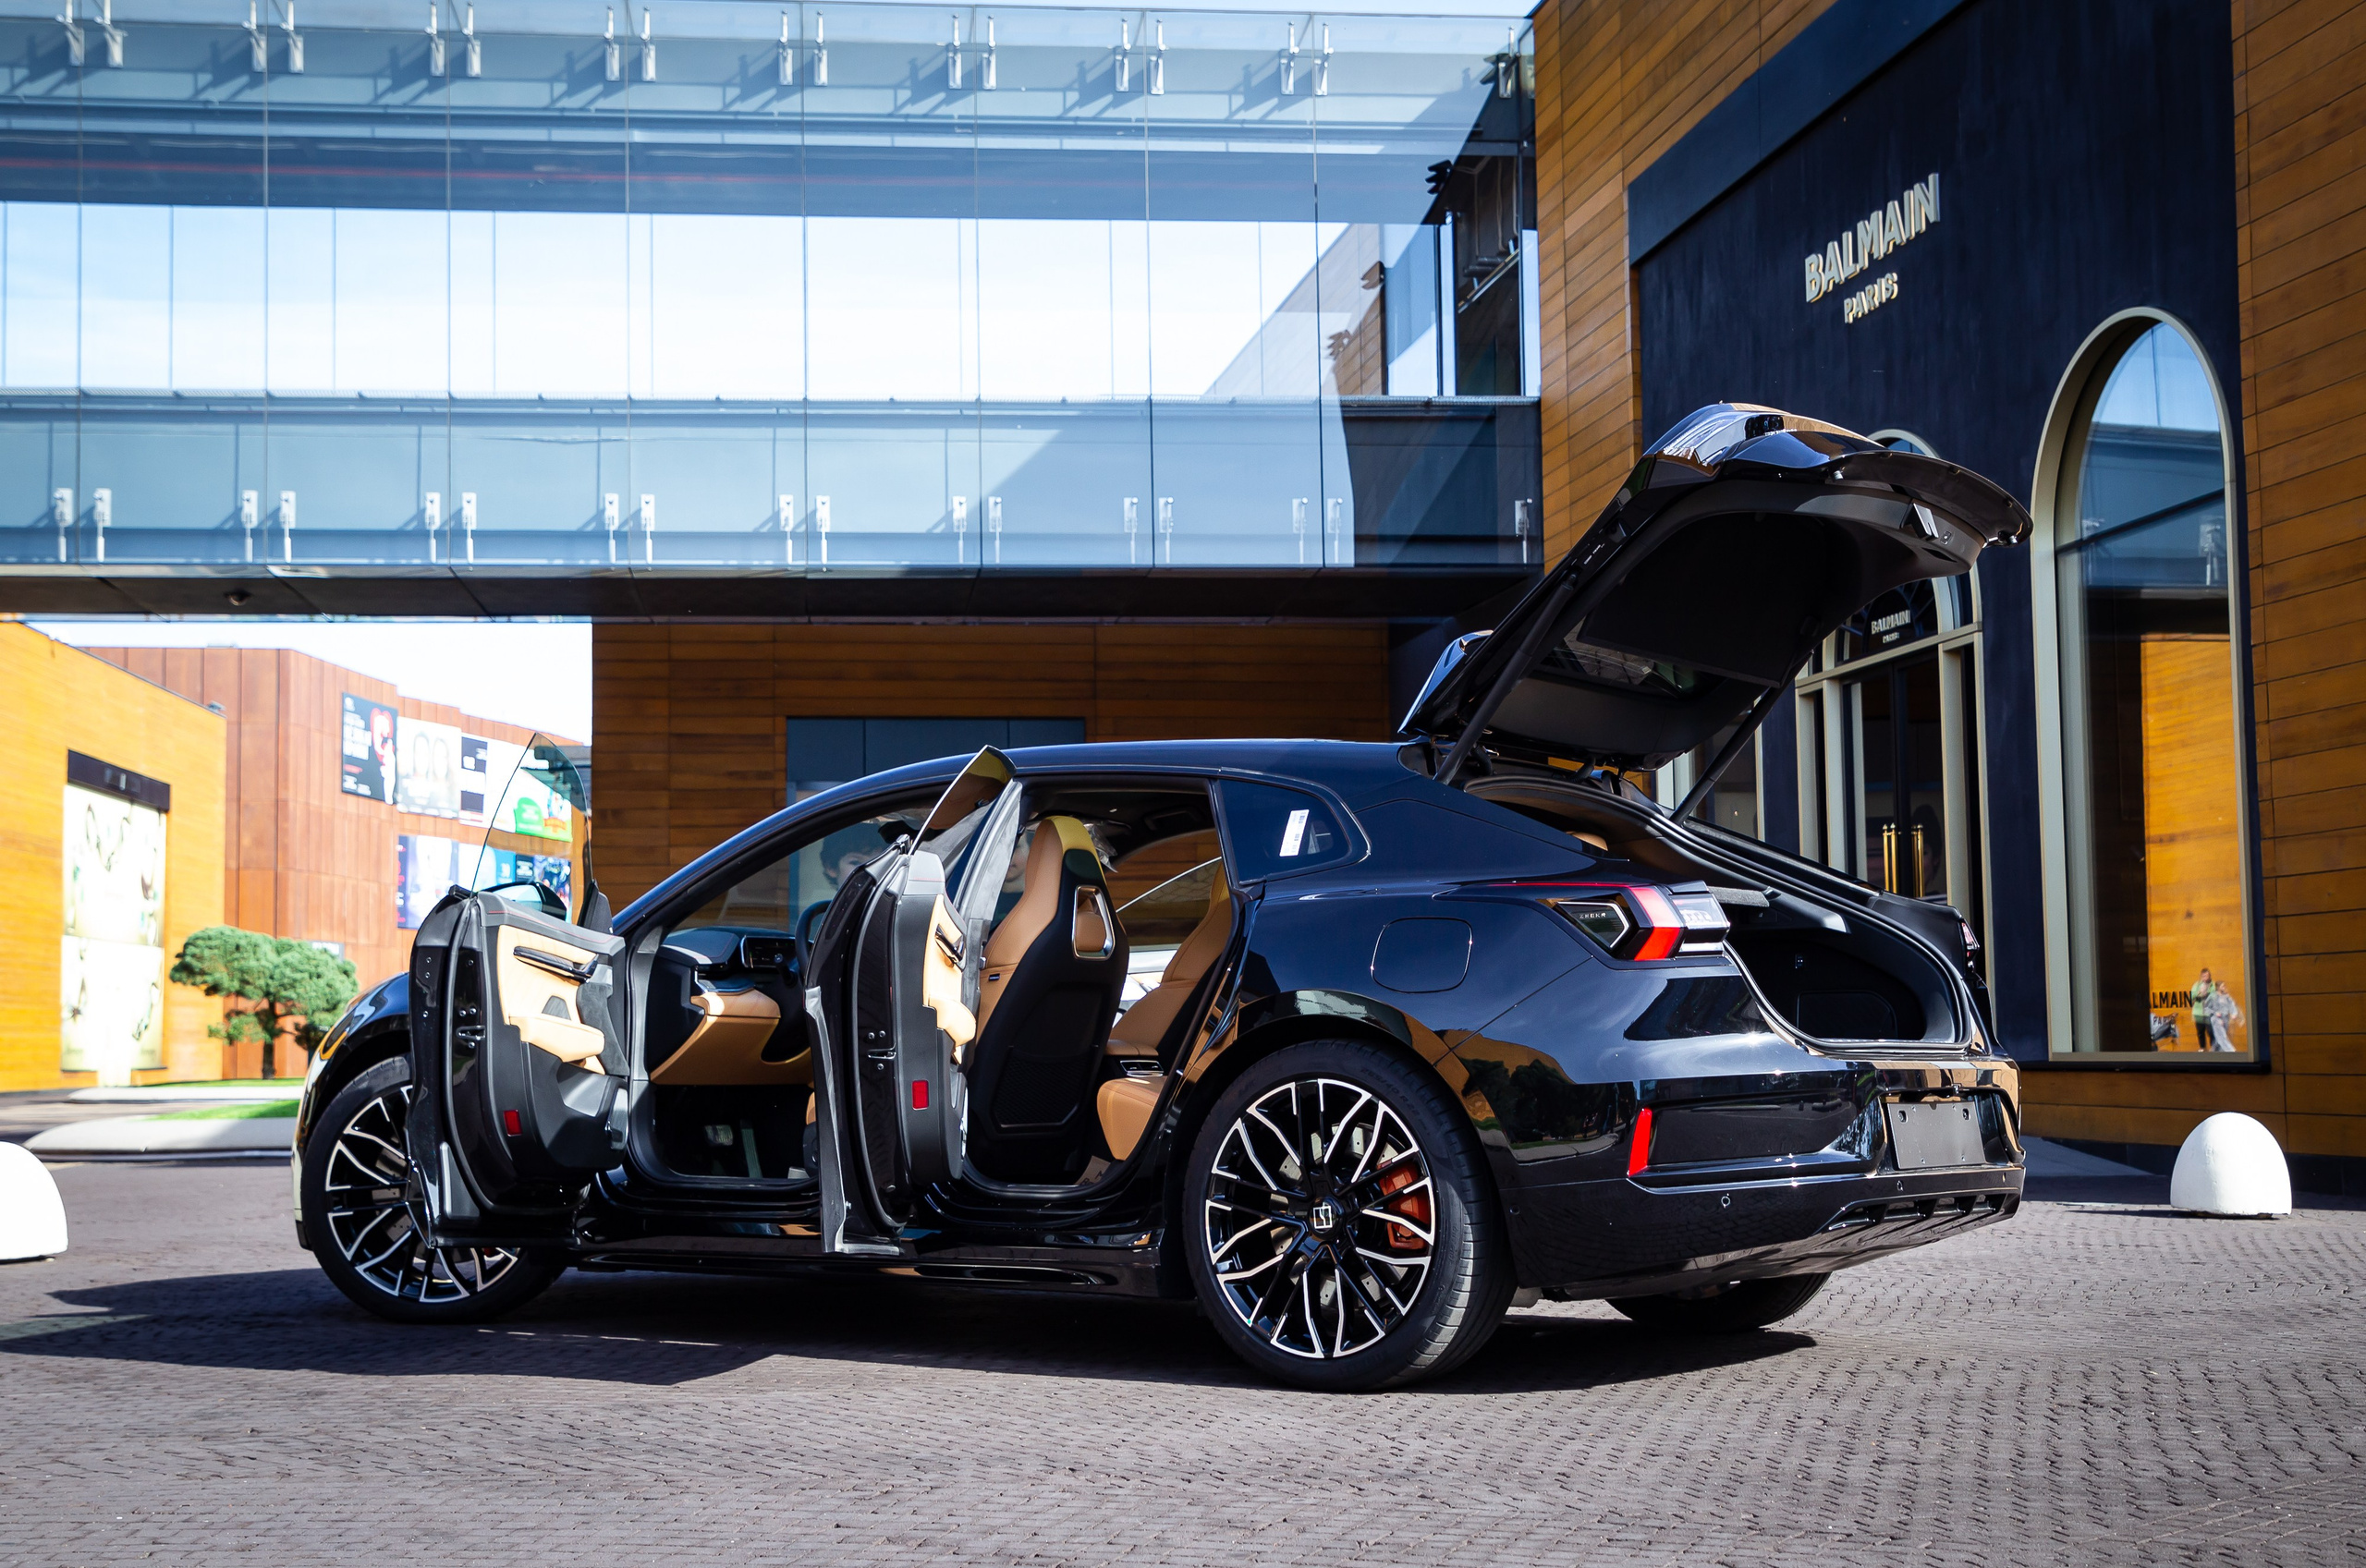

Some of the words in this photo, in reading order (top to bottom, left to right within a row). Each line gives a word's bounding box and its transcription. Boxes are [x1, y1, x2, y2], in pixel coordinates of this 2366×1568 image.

[1805, 172, 1940, 302] BALMAIN
[1844, 273, 1897, 323] PARIS
[1872, 610, 1910, 635] BALMAIN
